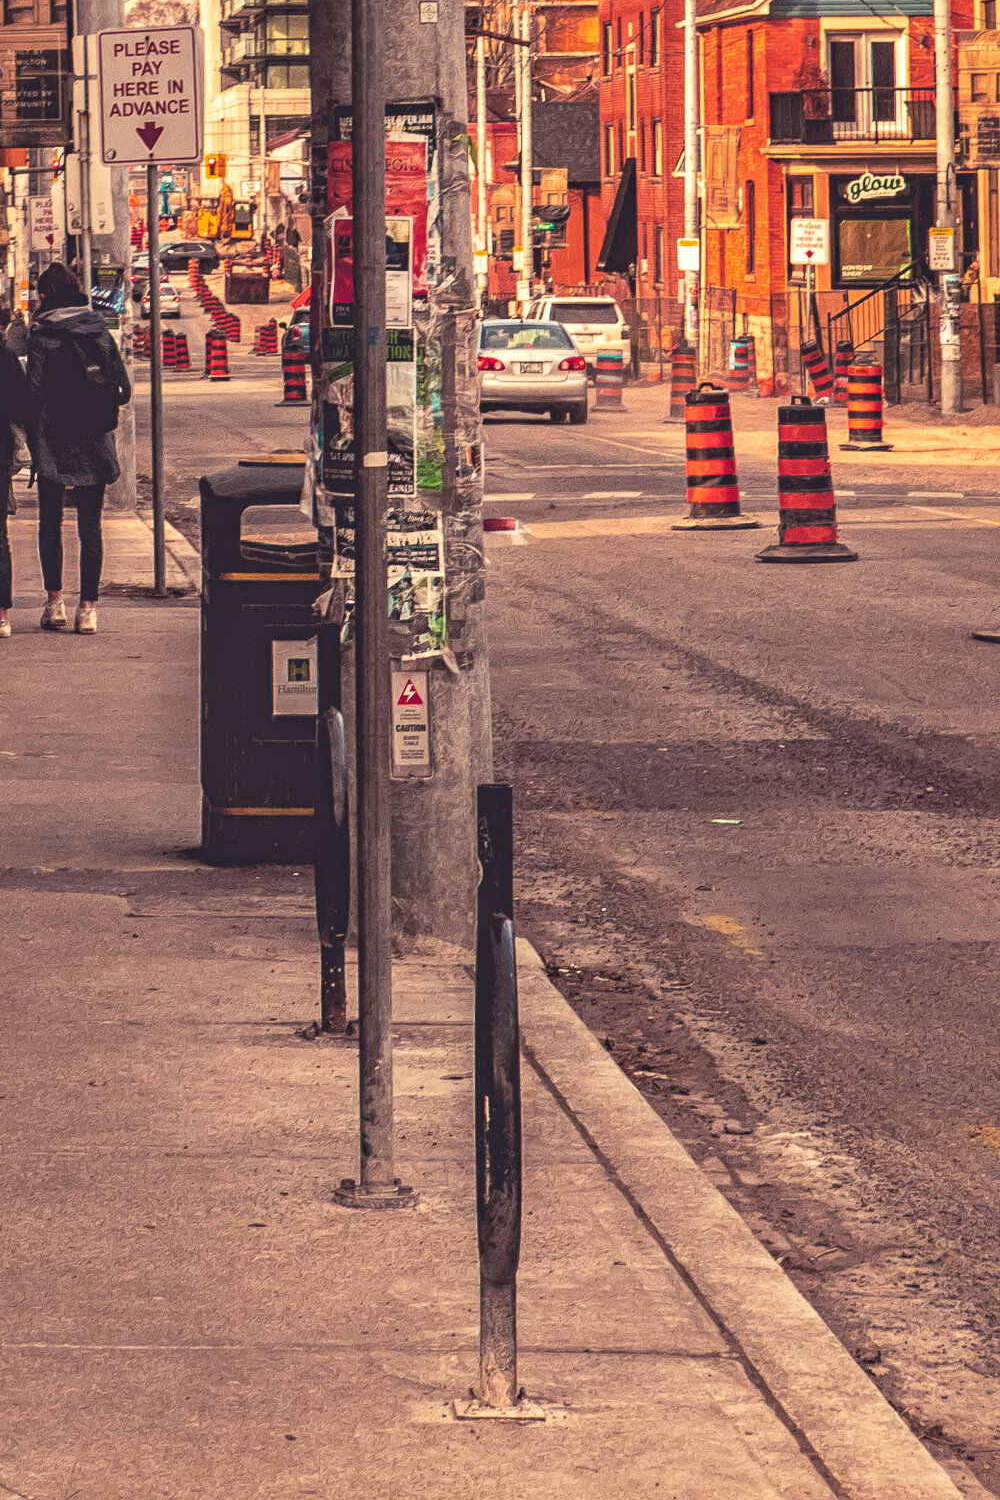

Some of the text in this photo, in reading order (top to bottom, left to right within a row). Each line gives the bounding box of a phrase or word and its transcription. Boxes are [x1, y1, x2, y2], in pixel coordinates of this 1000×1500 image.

[114, 40, 181, 58] PLEASE
[132, 60, 164, 77] PAY
[113, 79, 184, 97] HERE IN
[109, 99, 190, 118] ADVANCE
[850, 175, 903, 201] glow
[395, 724, 427, 733] CAUTION
